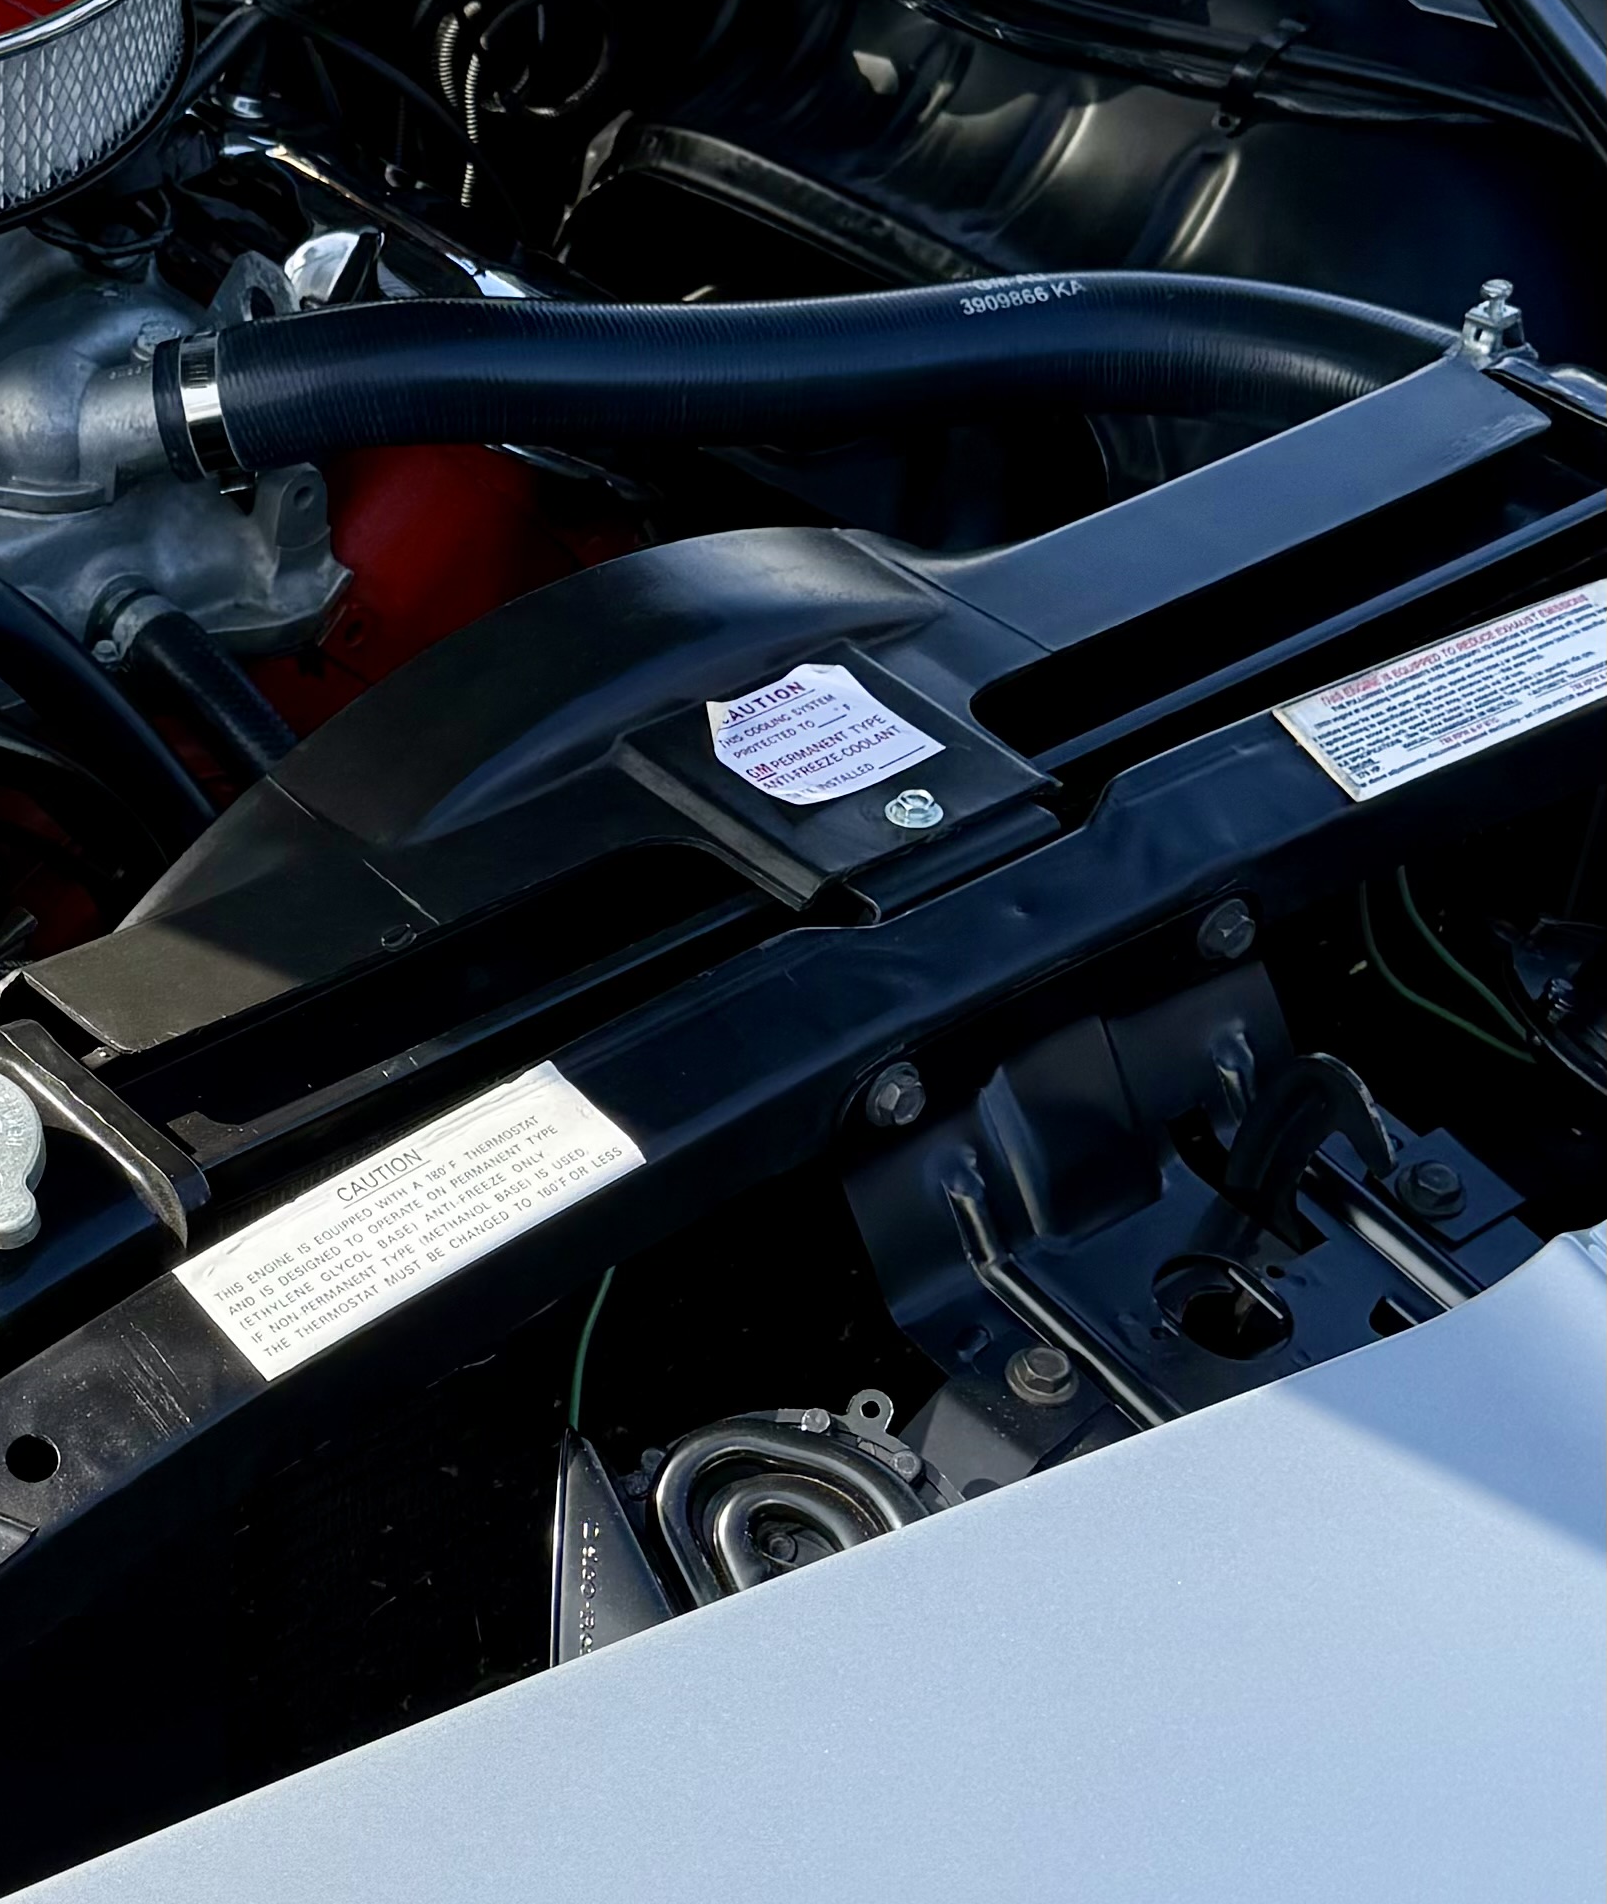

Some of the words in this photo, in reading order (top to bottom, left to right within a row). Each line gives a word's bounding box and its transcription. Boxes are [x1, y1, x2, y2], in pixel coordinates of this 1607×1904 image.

[960, 286, 1049, 315] 3909866
[1050, 280, 1086, 299] KA
[1439, 645, 1457, 657] TO
[1454, 630, 1496, 651] REDUCE
[1492, 612, 1539, 635] EXHAUST
[790, 692, 837, 716] SYSTEM
[796, 719, 816, 731] TO
[744, 761, 774, 780] GM
[769, 729, 849, 771] PERMANENT
[847, 713, 887, 735] TYPE
[213, 1280, 245, 1303] THIS
[244, 1251, 295, 1284] ENGINE
[295, 1241, 312, 1255] IS
[312, 1206, 375, 1245] EQUIPPED
[373, 1186, 409, 1210] WITH
[409, 1179, 424, 1190] A
[461, 1113, 540, 1162] THERMOSTAT
[333, 1147, 423, 1204] CAUTION
[225, 1294, 257, 1317] AND
[257, 1283, 276, 1298] IS
[276, 1244, 343, 1286] DESIGNED
[342, 1231, 365, 1248] TO
[365, 1198, 424, 1235] OPERATE
[424, 1185, 448, 1202] ON
[448, 1142, 524, 1189] PERMANENT
[524, 1123, 559, 1147] TYPE
[236, 1280, 316, 1330] (ETHYLENE
[317, 1247, 374, 1283] GLYCOL
[375, 1220, 420, 1250] BASE)
[421, 1170, 508, 1224] ANTI-FREEZE
[262, 1336, 292, 1358] THE
[292, 1283, 382, 1340] THERMOSTAT
[382, 1259, 424, 1287] MUST
[424, 1246, 446, 1263] BE
[446, 1208, 511, 1250] CHANGED
[512, 1196, 534, 1212] TO
[566, 1164, 590, 1181] OR
[589, 1145, 624, 1169] LESS
[249, 1329, 267, 1344] IF
[266, 1263, 380, 1334] NON-PERMANENT
[380, 1242, 416, 1267] TYPE
[416, 1199, 493, 1247] (METHANOL
[532, 1167, 550, 1181] IS
